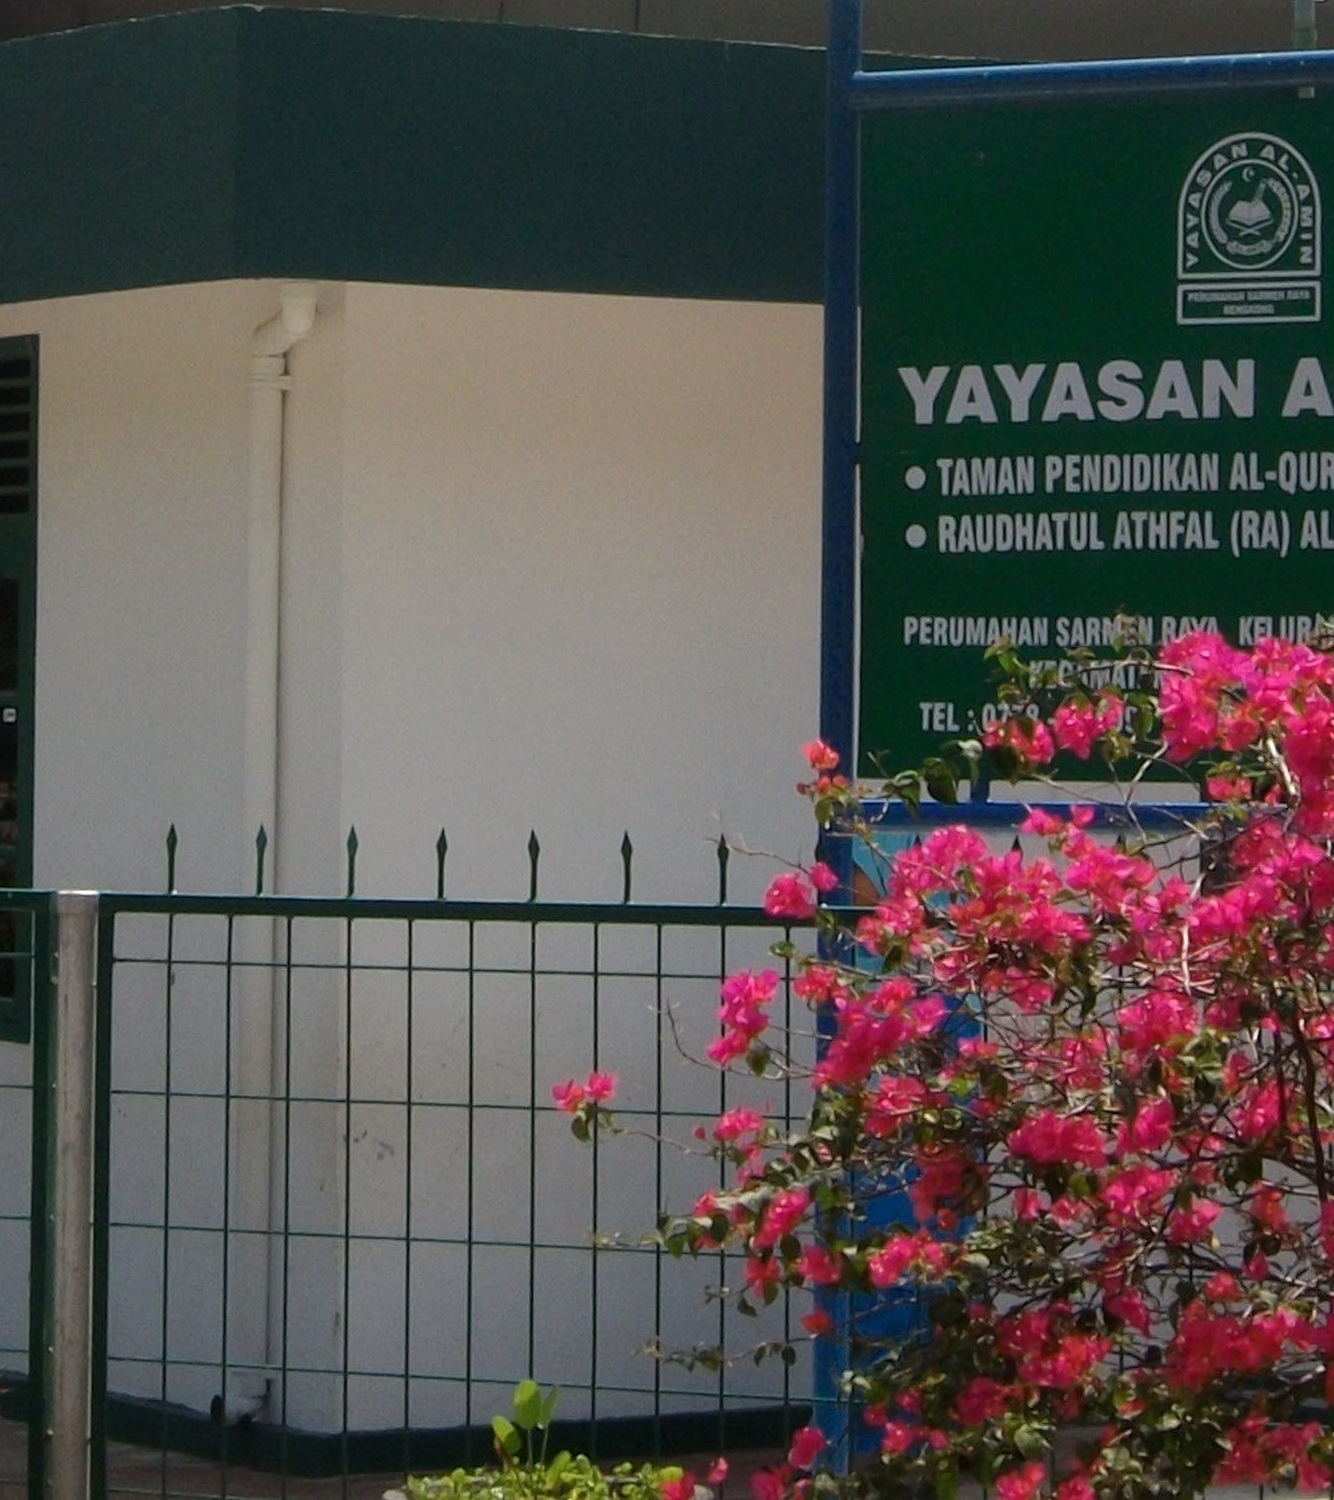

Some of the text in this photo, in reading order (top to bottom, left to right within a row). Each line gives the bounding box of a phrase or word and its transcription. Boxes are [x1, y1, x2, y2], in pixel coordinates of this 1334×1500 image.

[1185, 142, 1314, 269] YAYASAN AL-AMIN
[897, 359, 1255, 425] YAYASAN
[936, 456, 1035, 496] TAMAN
[1045, 453, 1219, 493] PENDIDIKAN
[938, 511, 1105, 553] RAUDHATUL
[1113, 510, 1220, 550] ATHFAL
[1230, 510, 1291, 559] (RA)
[903, 616, 1049, 647] PERUMAHAN
[1055, 615, 1154, 647] SARMEN
[919, 702, 960, 732] TEL
